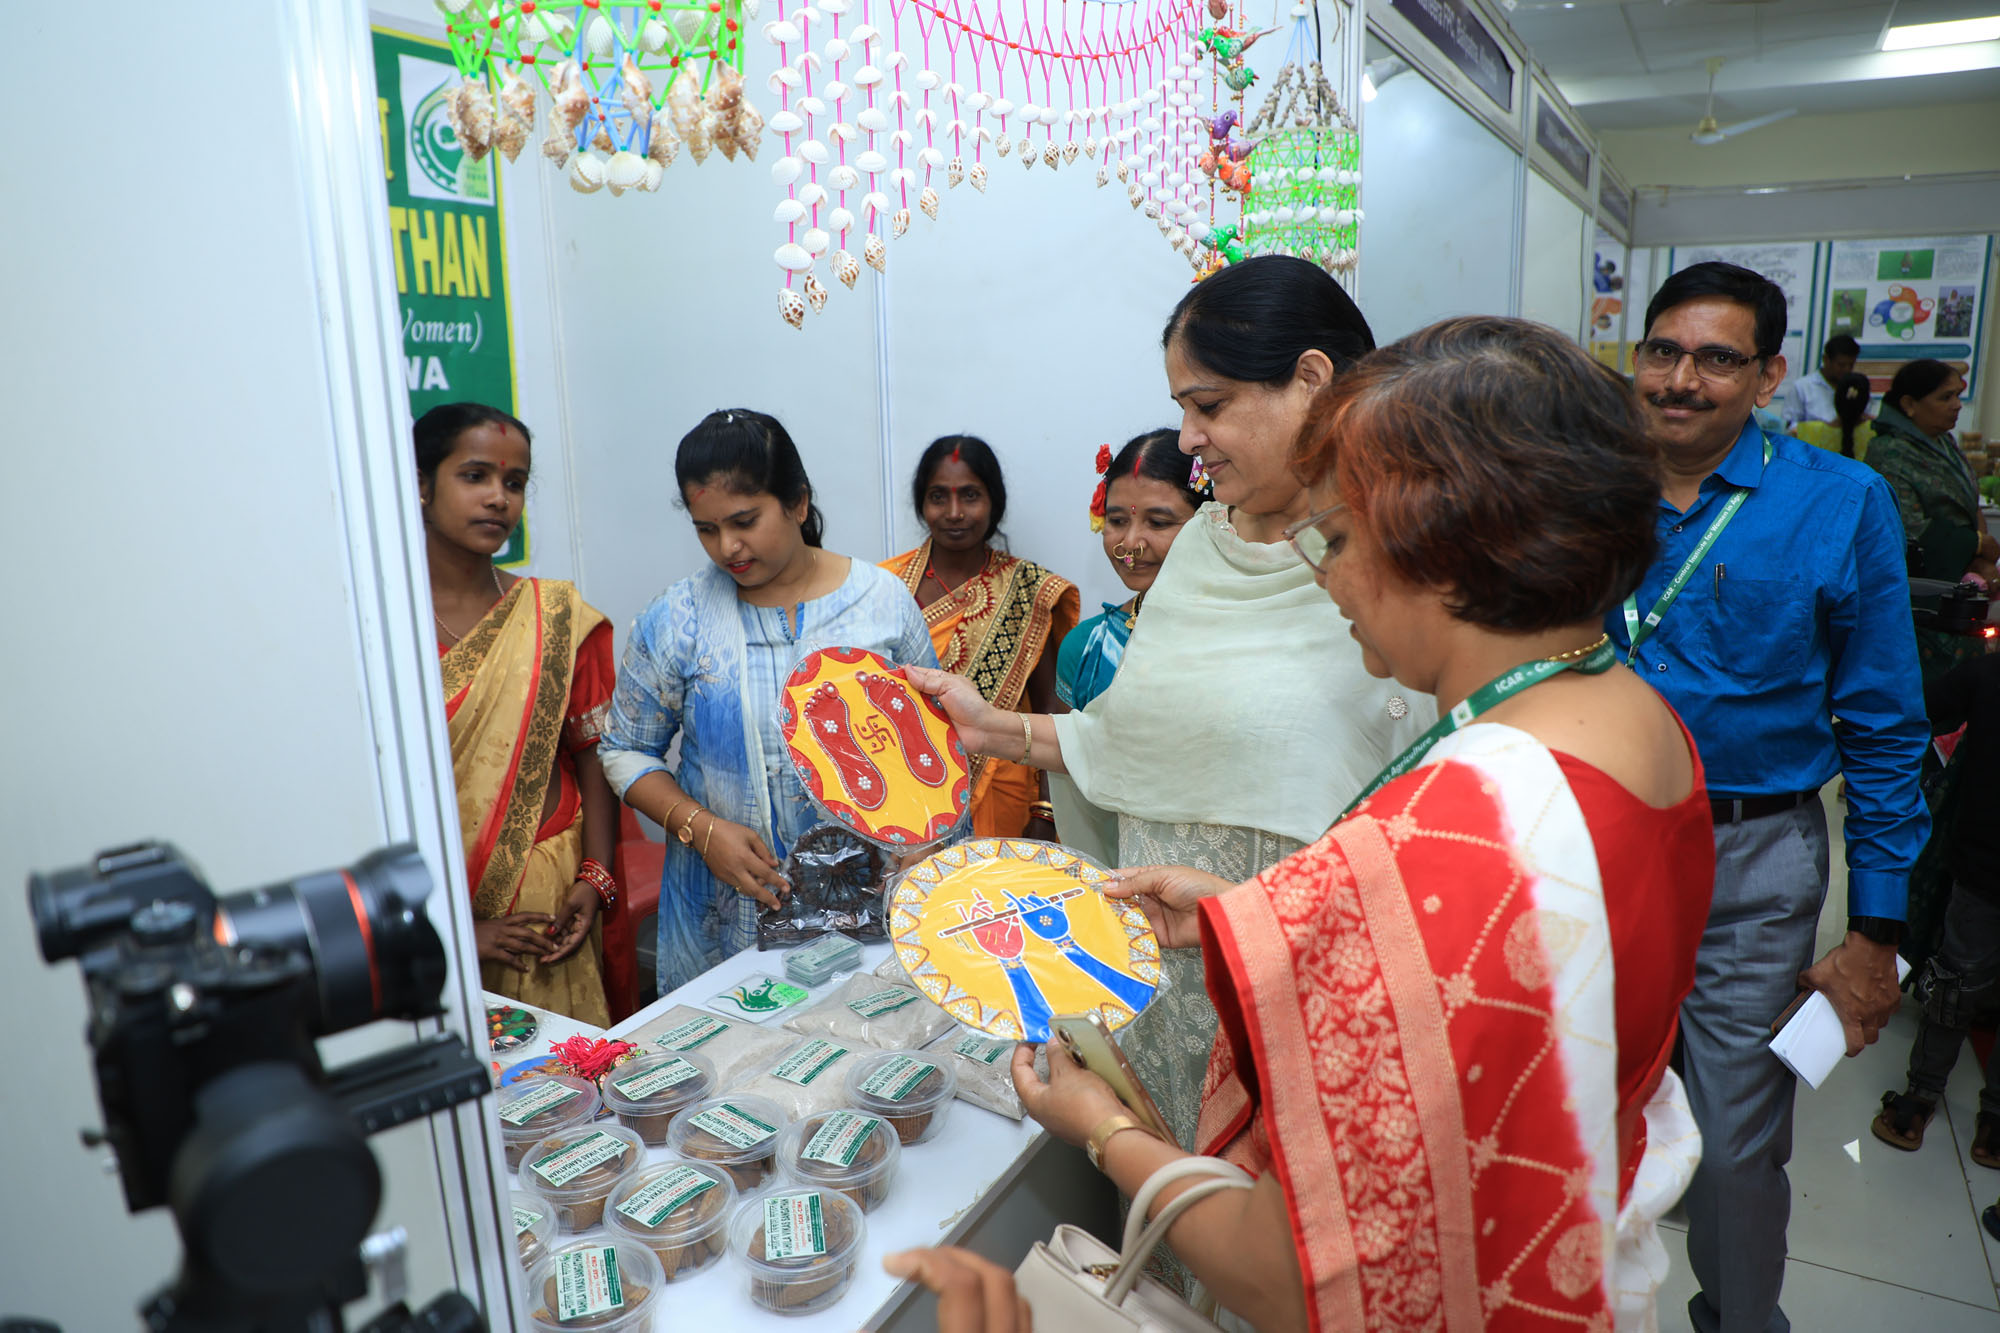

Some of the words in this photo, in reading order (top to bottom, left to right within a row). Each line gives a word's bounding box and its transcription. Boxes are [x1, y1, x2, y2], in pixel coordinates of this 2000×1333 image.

[1662, 587, 1675, 602] ICAR
[1674, 563, 1692, 584] Central
[1688, 540, 1707, 564] Institute
[1704, 531, 1713, 541] for
[1710, 510, 1729, 532] Women
[1726, 503, 1733, 511] in
[1494, 671, 1525, 694] ICAR
[1391, 737, 1432, 776] Agriculture
